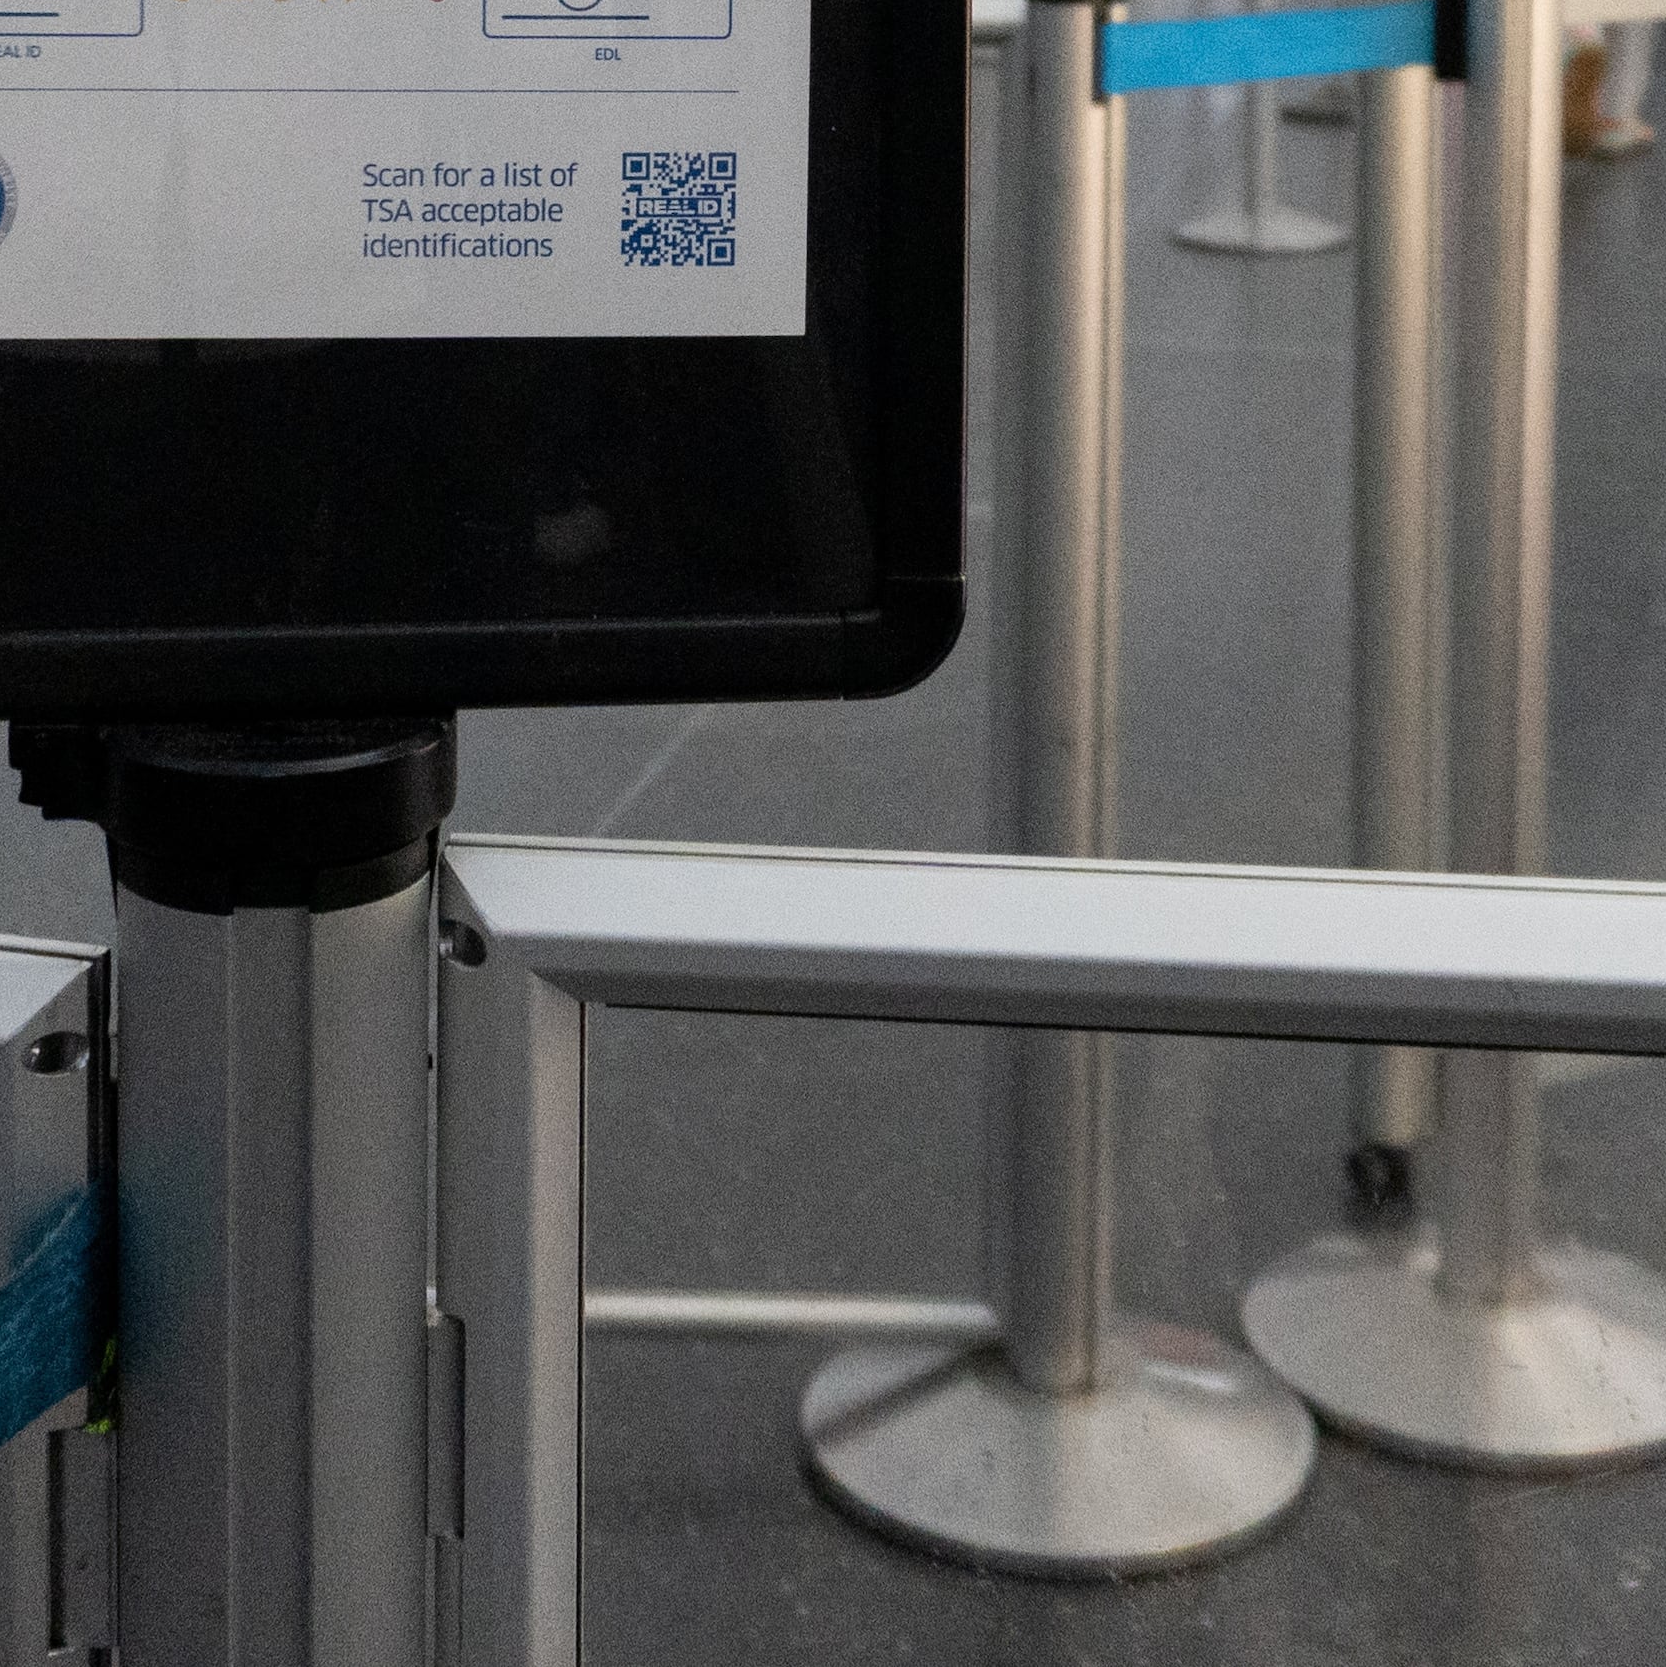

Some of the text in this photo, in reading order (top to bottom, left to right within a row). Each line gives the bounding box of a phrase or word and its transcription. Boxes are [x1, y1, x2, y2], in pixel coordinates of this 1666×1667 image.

[25, 44, 42, 59] ID
[594, 47, 622, 62] EDL
[362, 161, 578, 188] Scan for a list of
[362, 197, 564, 227] TSA acceptable
[363, 232, 554, 259] identifications
